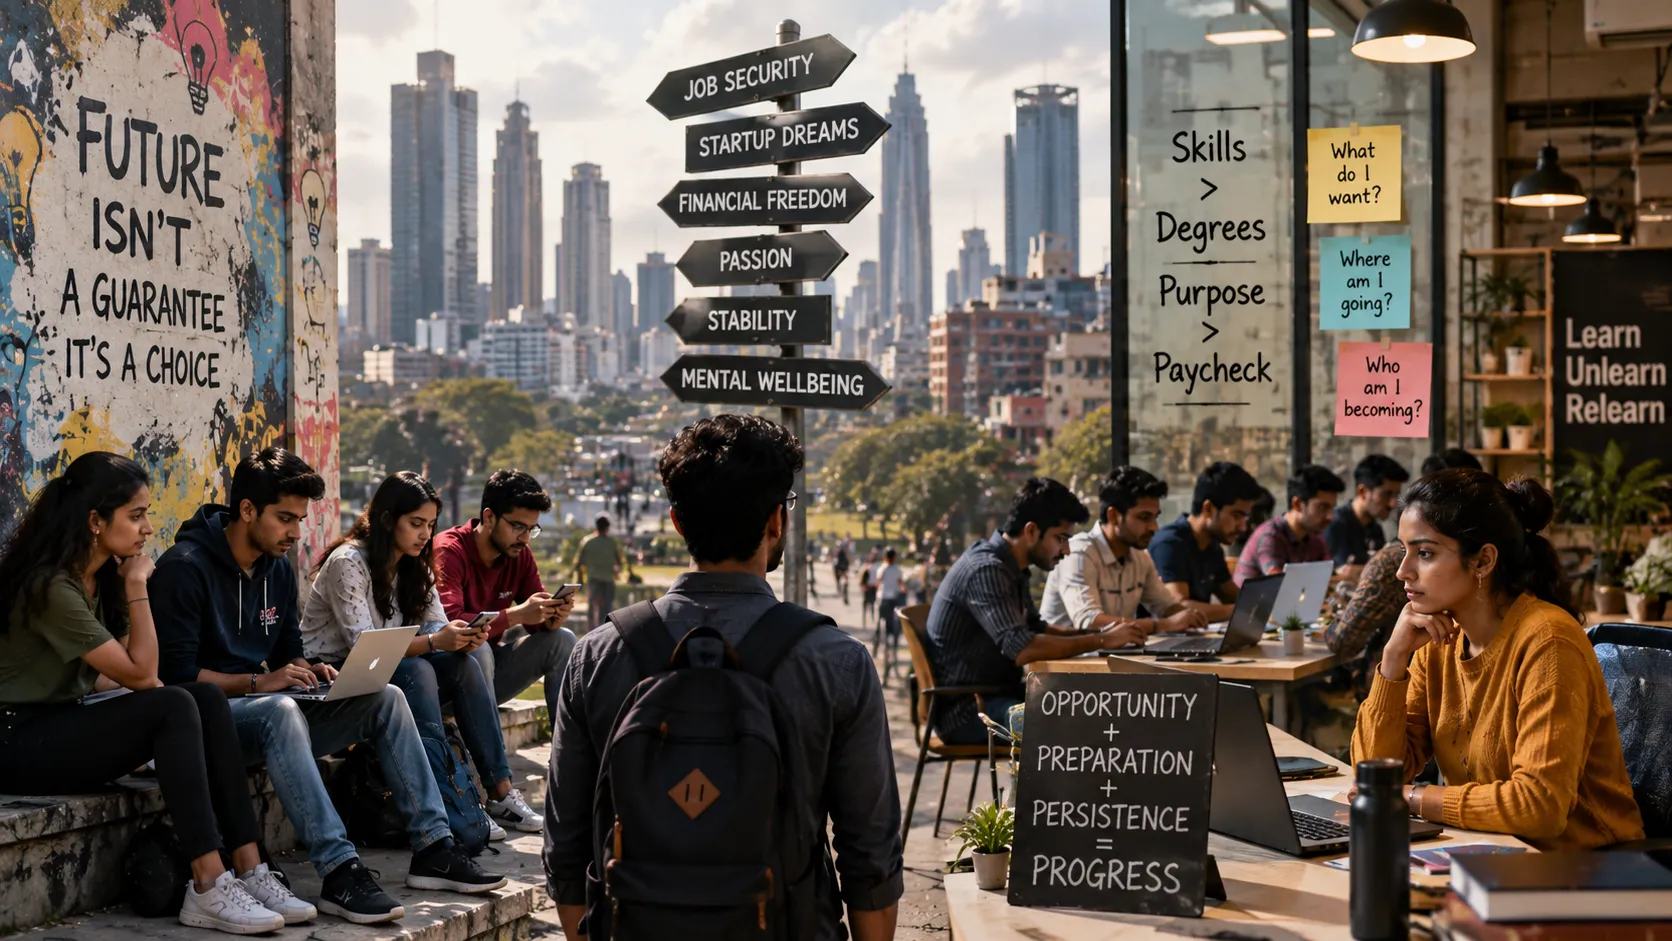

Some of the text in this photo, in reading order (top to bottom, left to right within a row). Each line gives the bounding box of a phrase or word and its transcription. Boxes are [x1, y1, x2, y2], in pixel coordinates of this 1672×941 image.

[683, 52, 815, 102] JOB SECURITY
[77, 95, 225, 208] FUTURE
[699, 117, 860, 157] STARTUP DREAMS
[1172, 129, 1247, 163] Skills
[1330, 140, 1376, 160] What
[1337, 164, 1370, 183] do I
[679, 187, 847, 213] FINANCIAL FREEDOM
[1328, 184, 1382, 206] want?
[92, 196, 192, 267] ISN'T
[1155, 210, 1266, 255] Degrees
[720, 247, 793, 272] PASSION
[1339, 248, 1391, 268] Where
[1159, 274, 1266, 317] Purpose
[1346, 271, 1383, 289] am I
[59, 267, 226, 334] A GUARANTEE
[1340, 291, 1393, 319] going?
[707, 309, 797, 331] STABILITY
[1566, 317, 1641, 349] Learn
[65, 334, 221, 389] IT'S A CHOICE
[1153, 351, 1273, 396] Paycheck
[1365, 354, 1401, 374] Who
[1566, 355, 1667, 387] Unlearn
[681, 367, 865, 396] MENTAL WELLBEING
[1363, 378, 1400, 396] am I
[1344, 398, 1423, 426] becoming?
[1566, 392, 1665, 424] Relearn
[1041, 690, 1198, 721] OPPORTUNITY
[1037, 744, 1193, 776] PREPARATION
[1032, 799, 1190, 833] PERSISTENCE
[1032, 854, 1181, 894] PROGRESS
